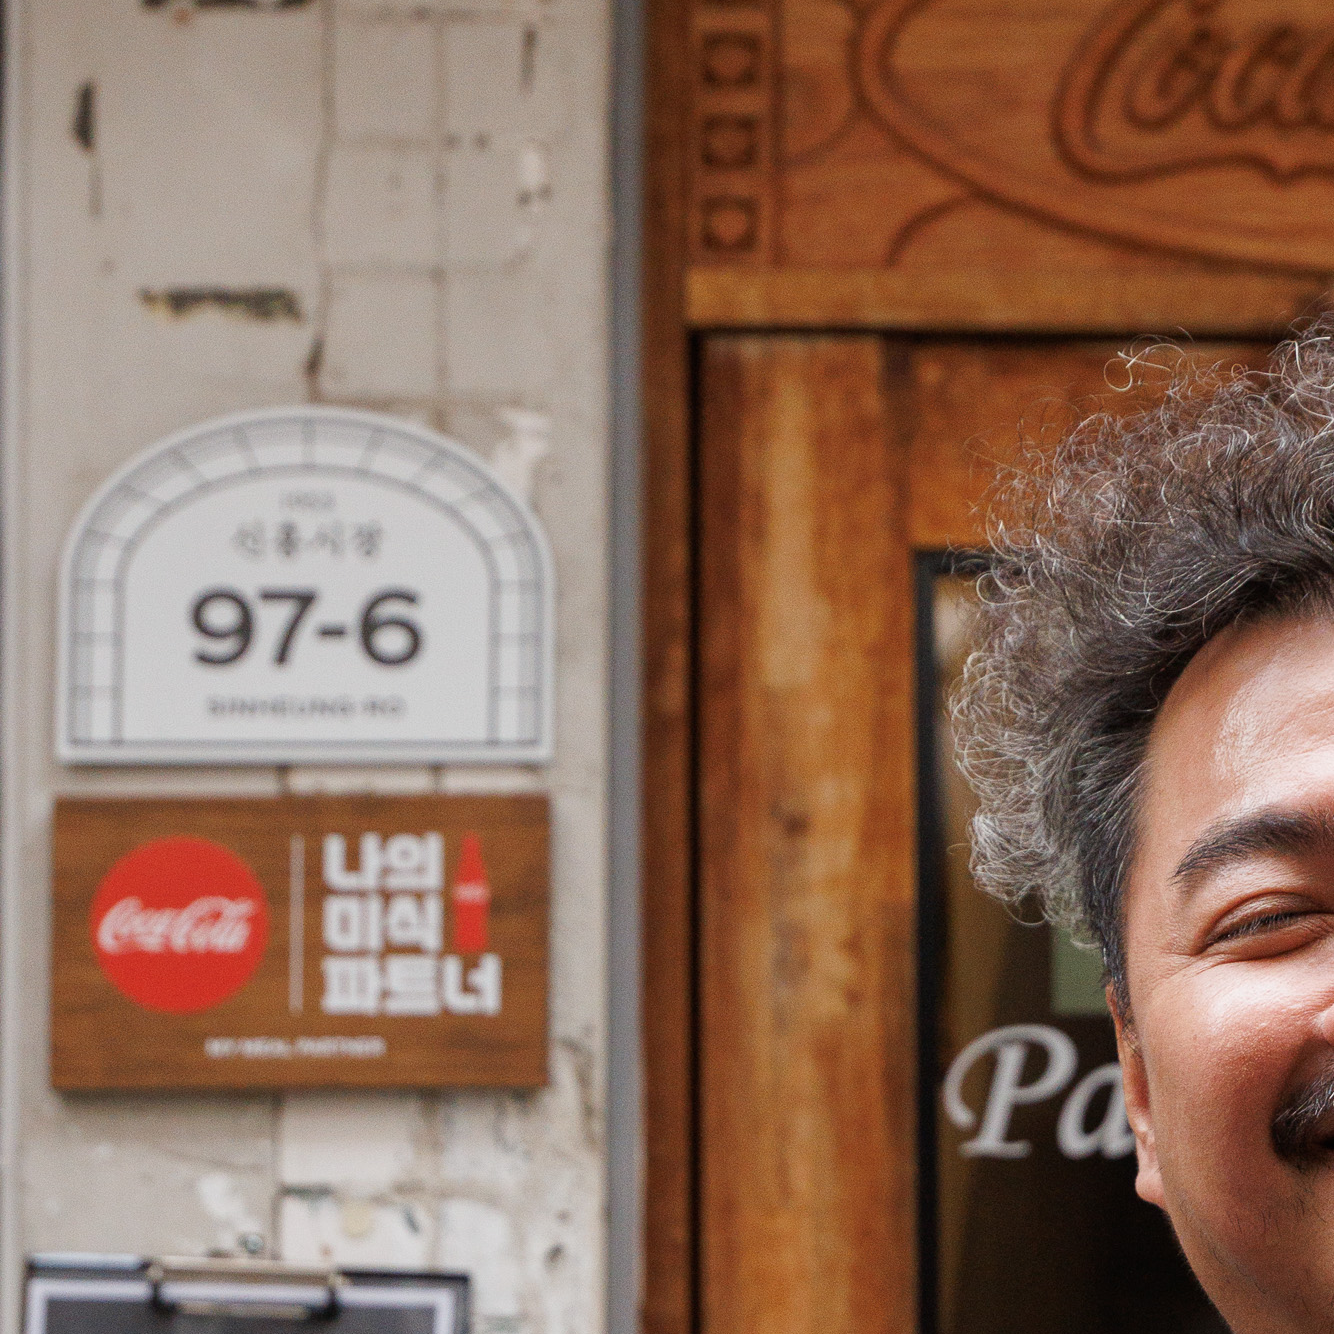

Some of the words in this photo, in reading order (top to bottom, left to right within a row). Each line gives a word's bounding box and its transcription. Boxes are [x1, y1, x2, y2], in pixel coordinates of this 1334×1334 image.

[189, 584, 426, 669] 97-6
[321, 830, 445, 891] 나의
[319, 953, 503, 1018] 파트너
[943, 1023, 1137, 1160] Pa
